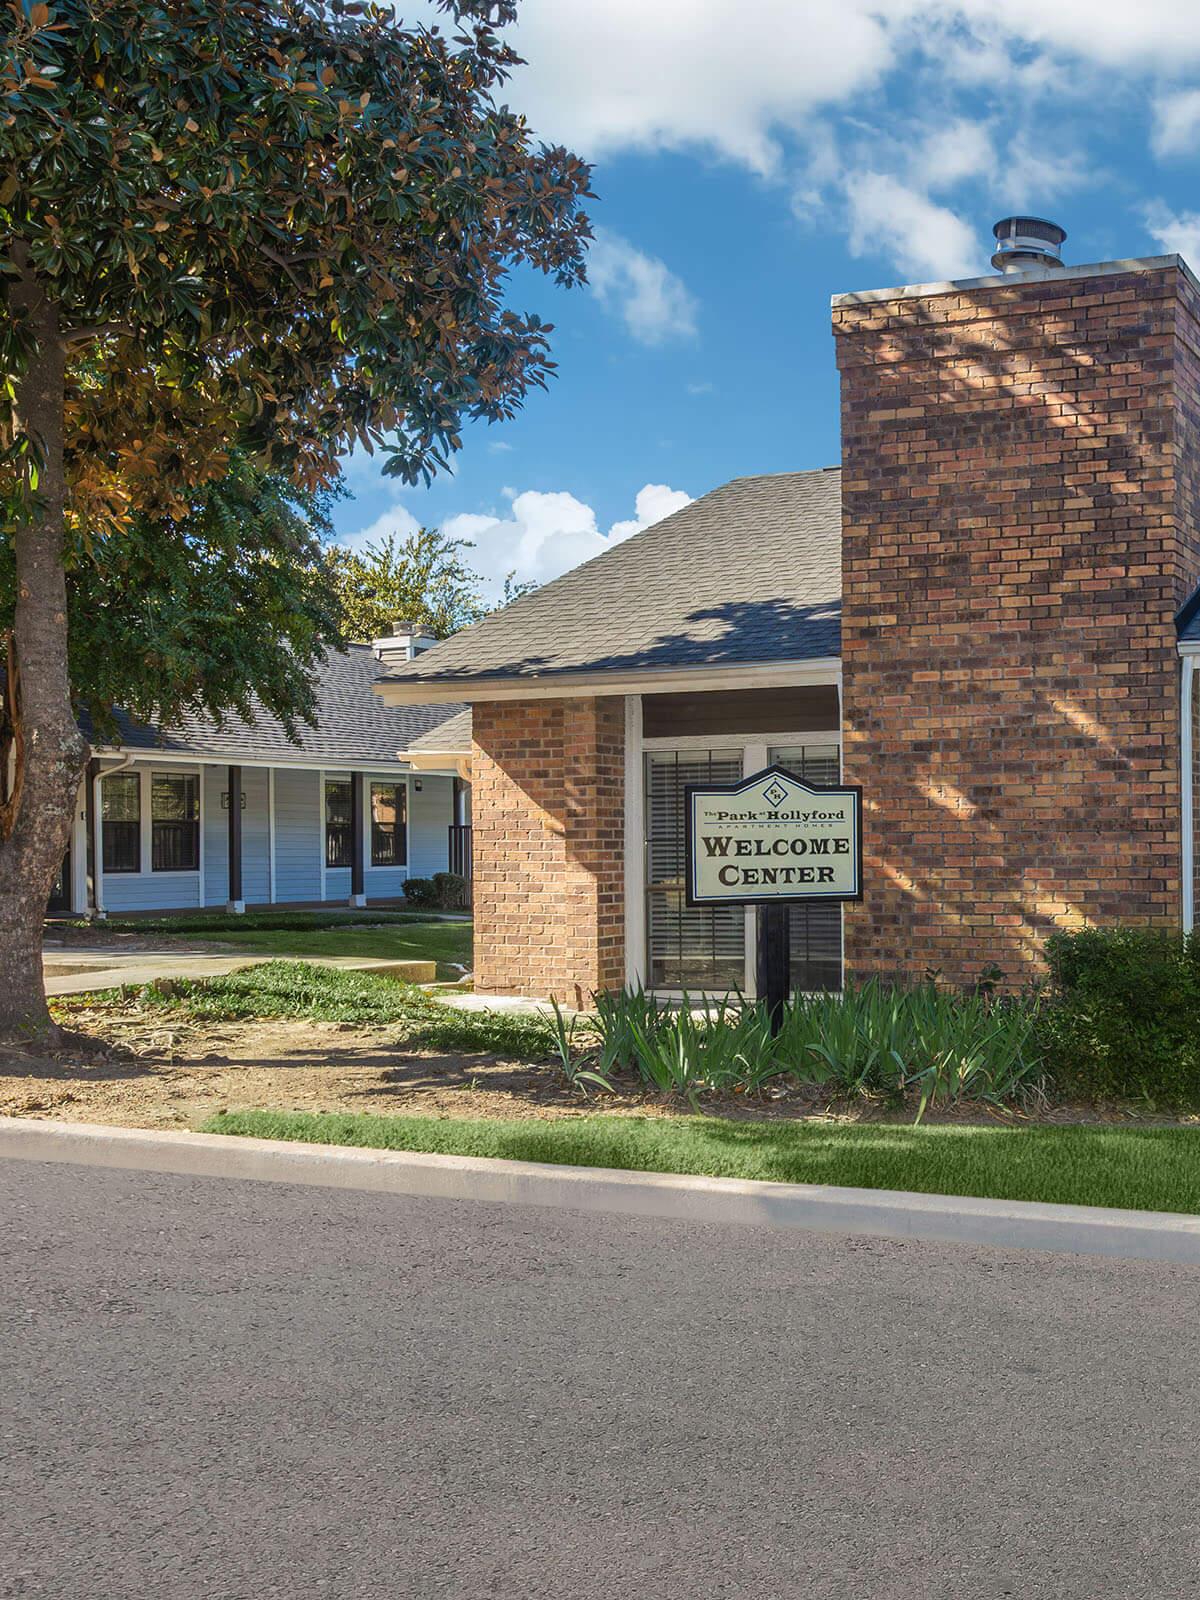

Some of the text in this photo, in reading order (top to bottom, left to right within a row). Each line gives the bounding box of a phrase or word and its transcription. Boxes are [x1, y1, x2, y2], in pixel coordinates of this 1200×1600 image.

[717, 811, 757, 821] Park
[767, 810, 845, 822] Hollyford
[701, 836, 849, 857] WELCOME
[718, 864, 835, 886] CENTER
